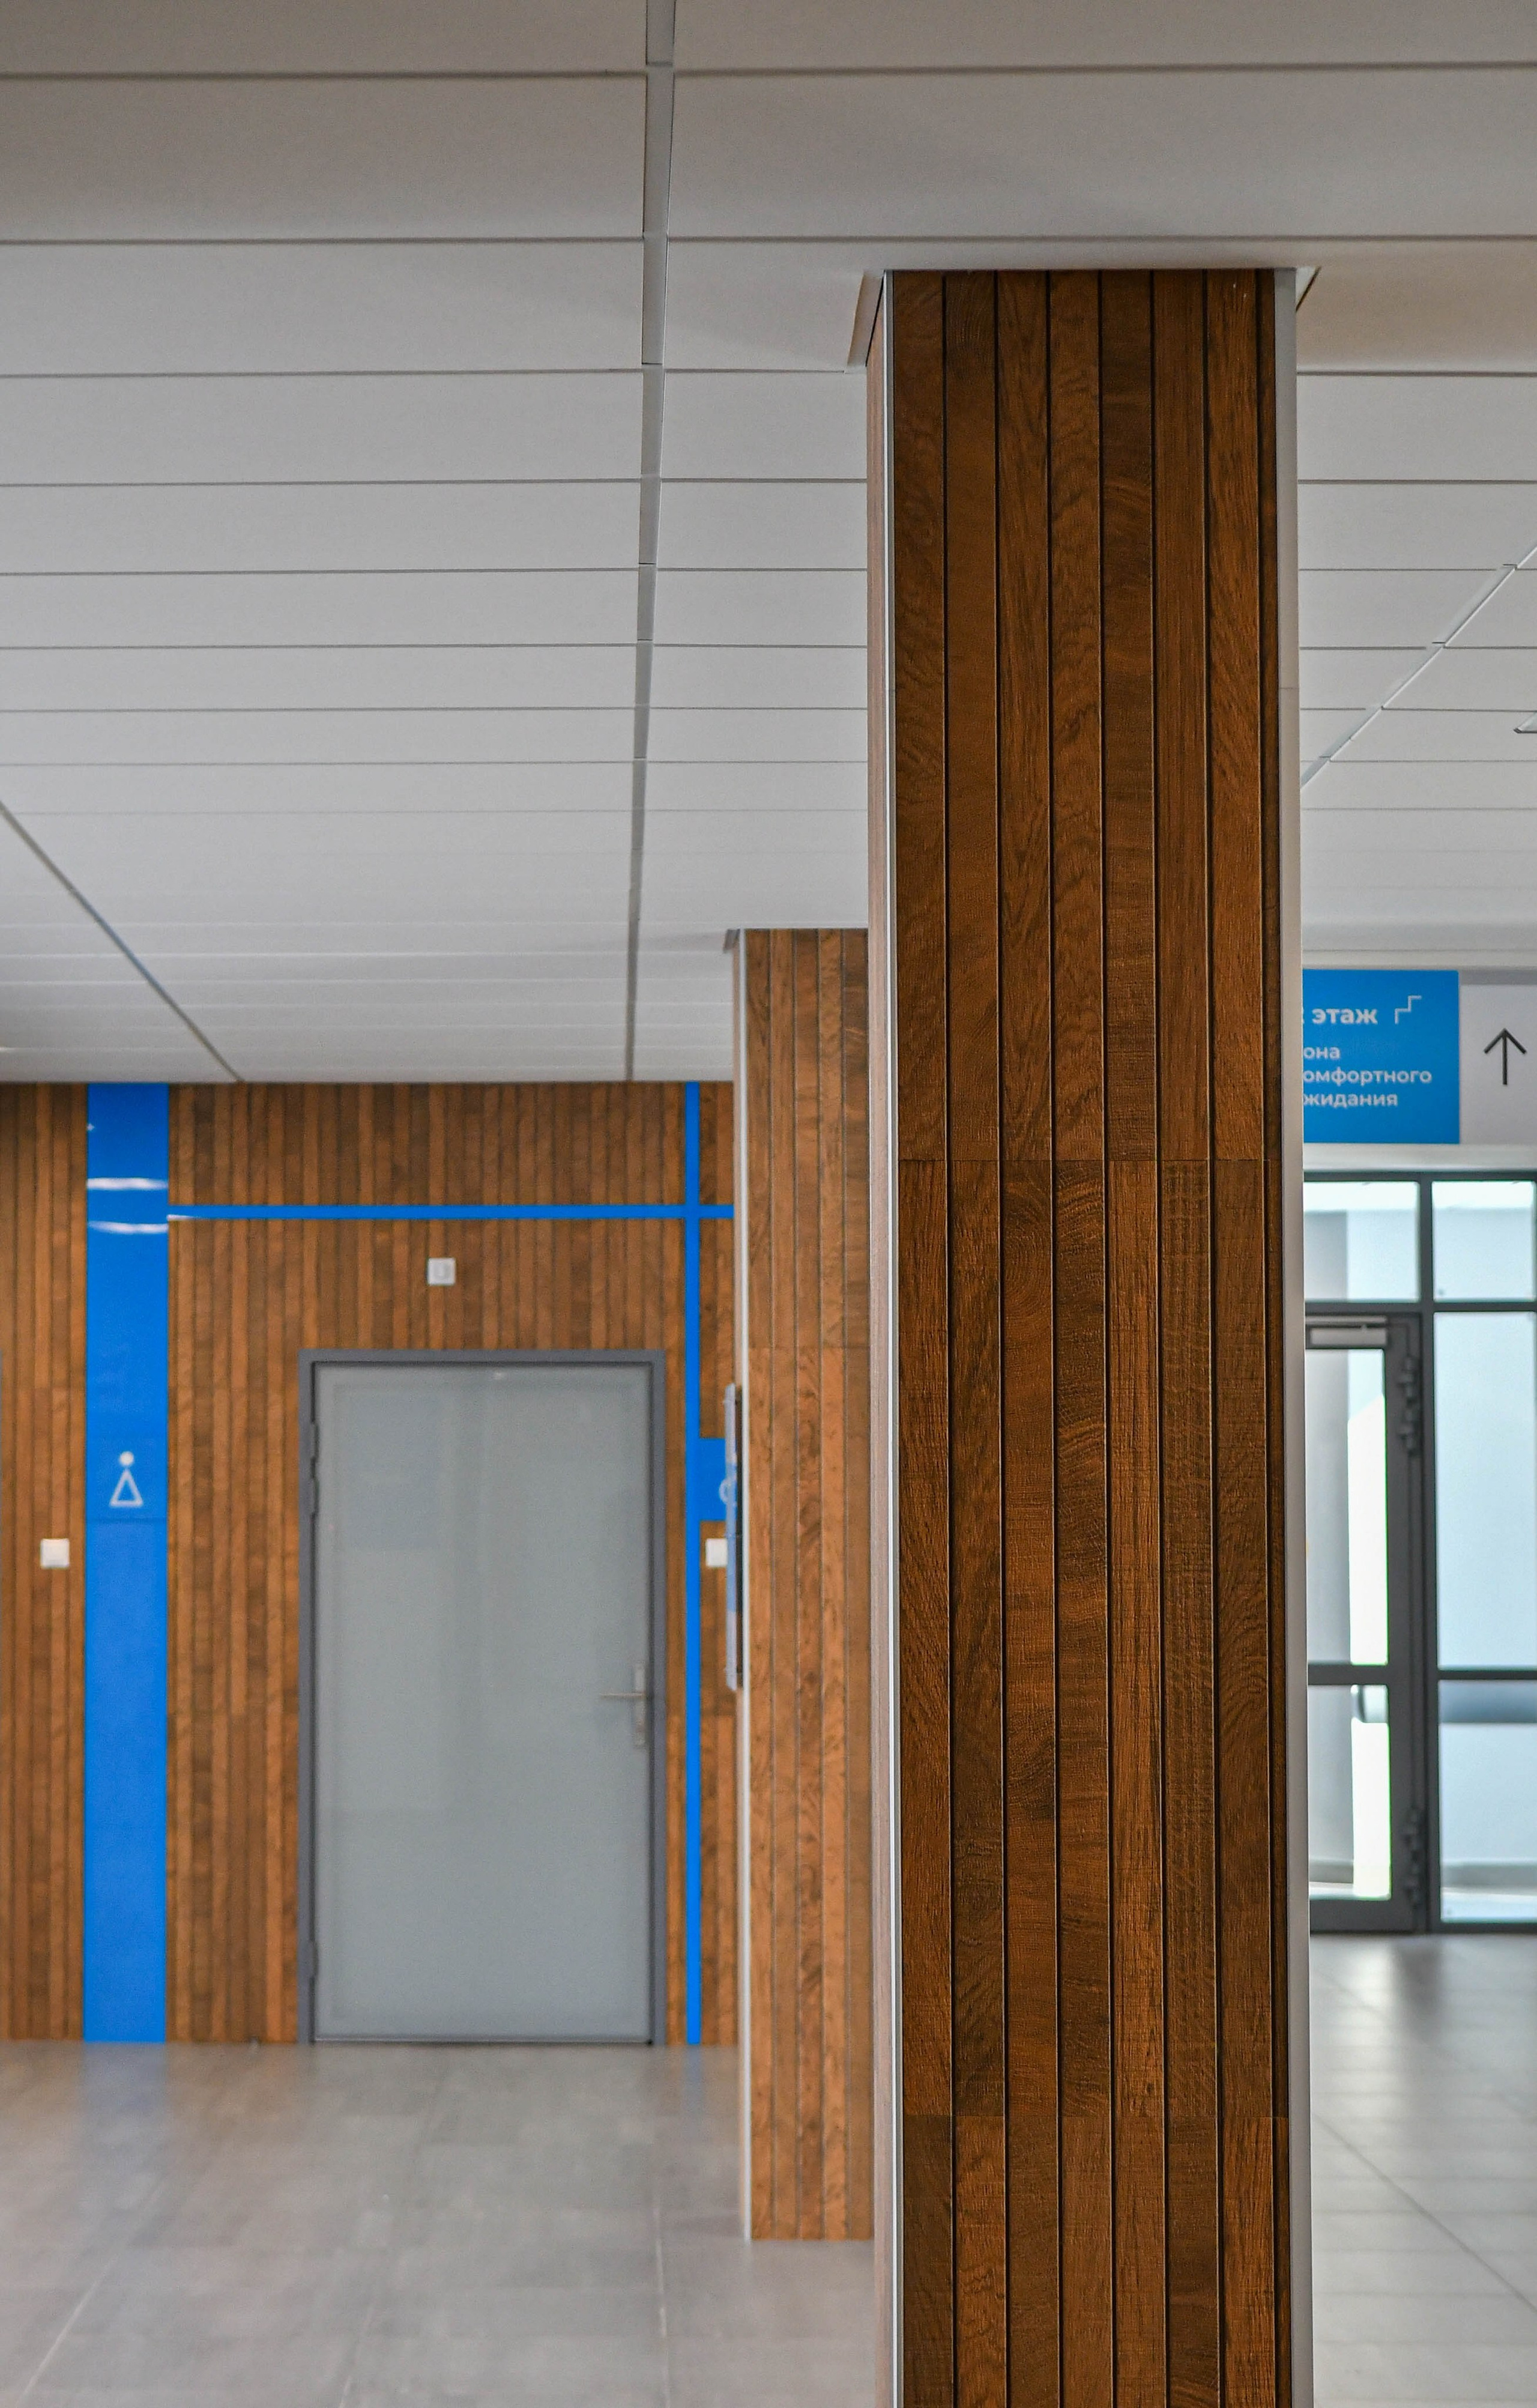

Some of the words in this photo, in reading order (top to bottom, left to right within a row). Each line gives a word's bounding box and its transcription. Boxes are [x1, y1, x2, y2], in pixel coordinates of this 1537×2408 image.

[1311, 1008, 1378, 1024] этаж
[1303, 1047, 1340, 1059] она
[1303, 1066, 1432, 1086] омфортного
[1303, 1094, 1398, 1108] жидания
